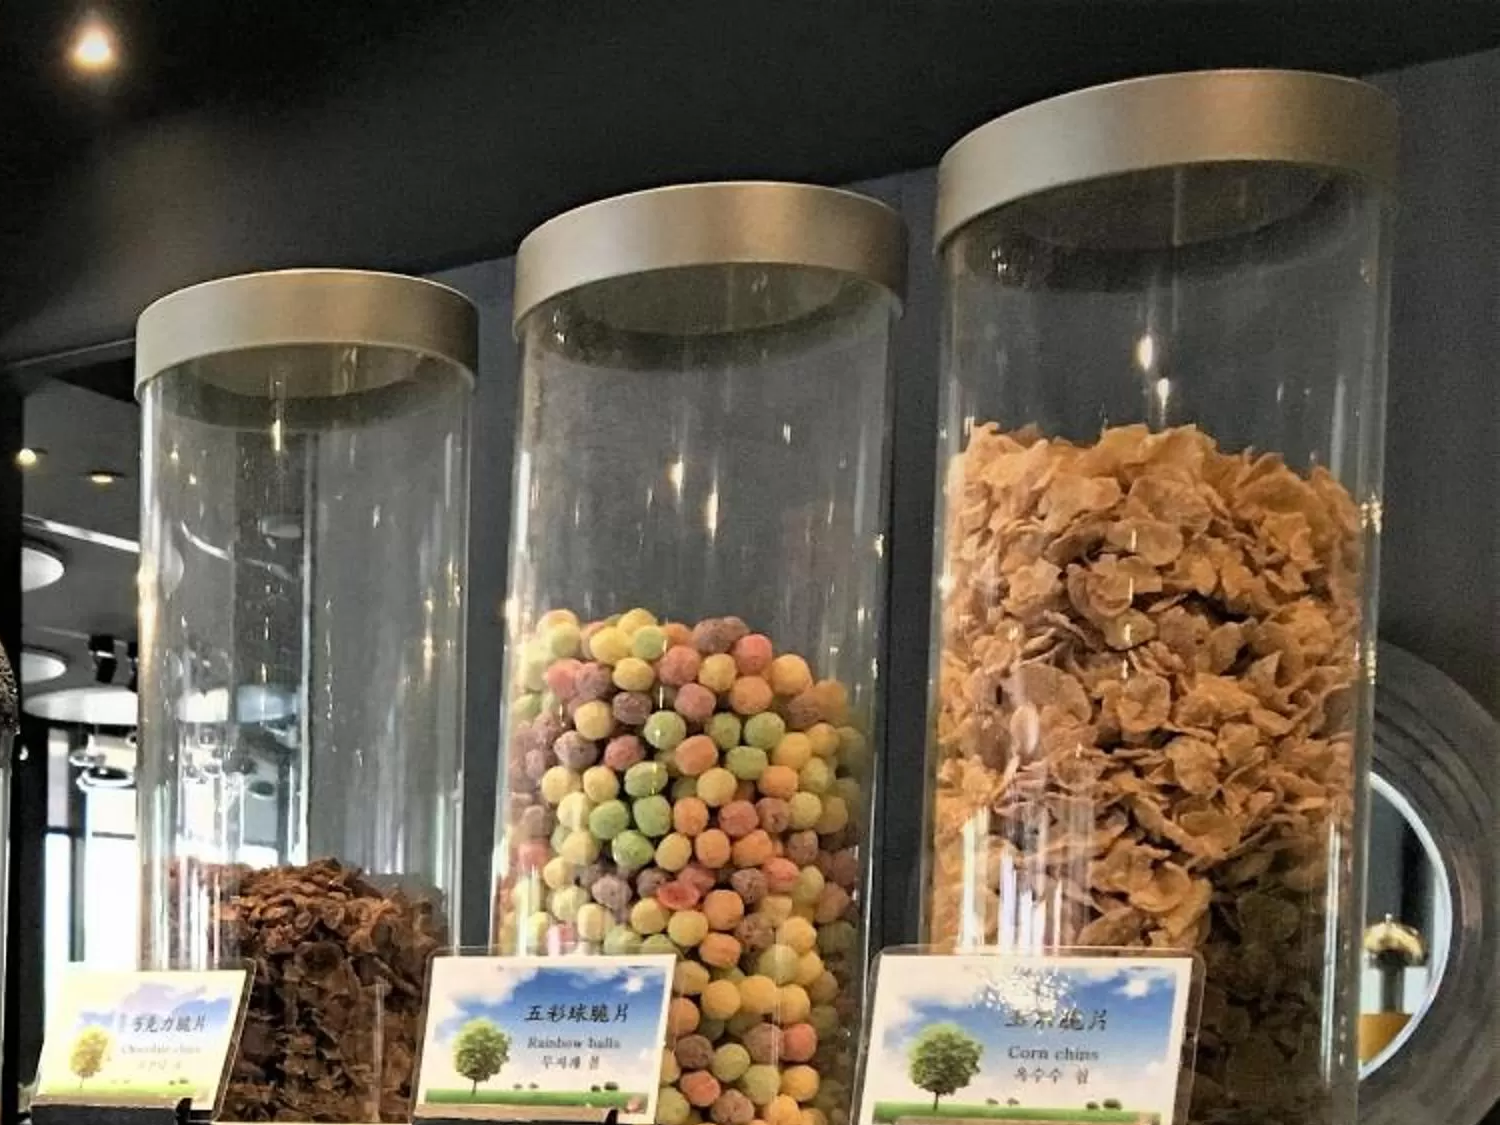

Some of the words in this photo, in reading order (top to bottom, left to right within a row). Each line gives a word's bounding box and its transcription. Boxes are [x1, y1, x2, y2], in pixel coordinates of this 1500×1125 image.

[524, 1003, 629, 1023] 五彩球脆片
[527, 1036, 582, 1049] Rainbow
[1008, 1046, 1049, 1060] Corn
[1056, 1047, 1099, 1062] chips
